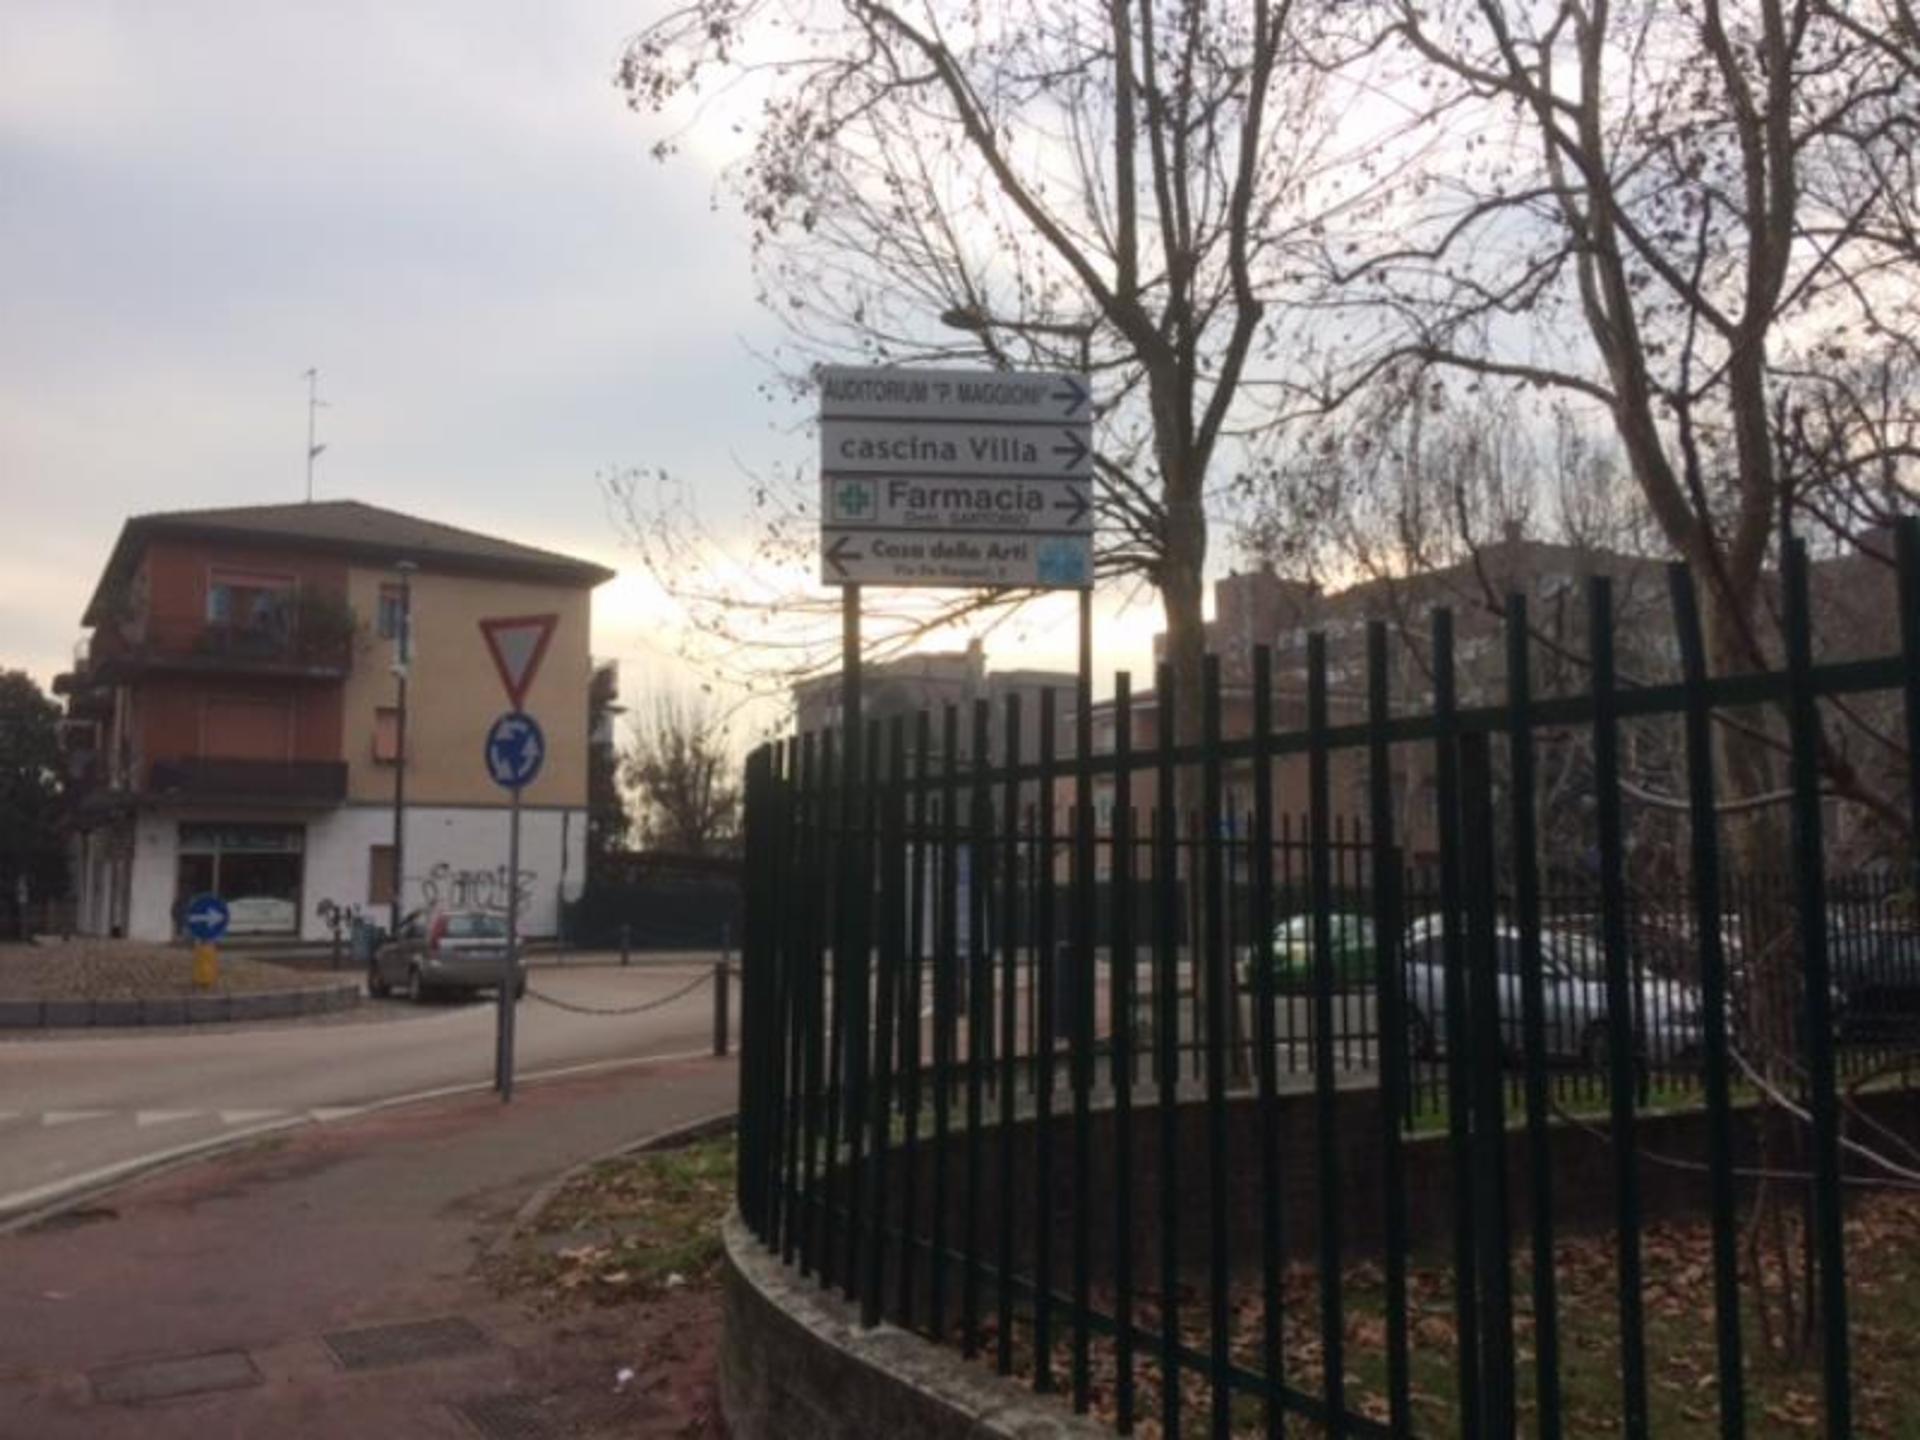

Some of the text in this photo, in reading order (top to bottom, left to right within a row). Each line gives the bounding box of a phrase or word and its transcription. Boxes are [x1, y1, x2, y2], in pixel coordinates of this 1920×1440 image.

[824, 379, 927, 402] AUDITORIUM
[841, 435, 1038, 463] cascina Villa
[888, 480, 1044, 511] Farmacia
[871, 538, 1028, 561] Casa delle Arti
